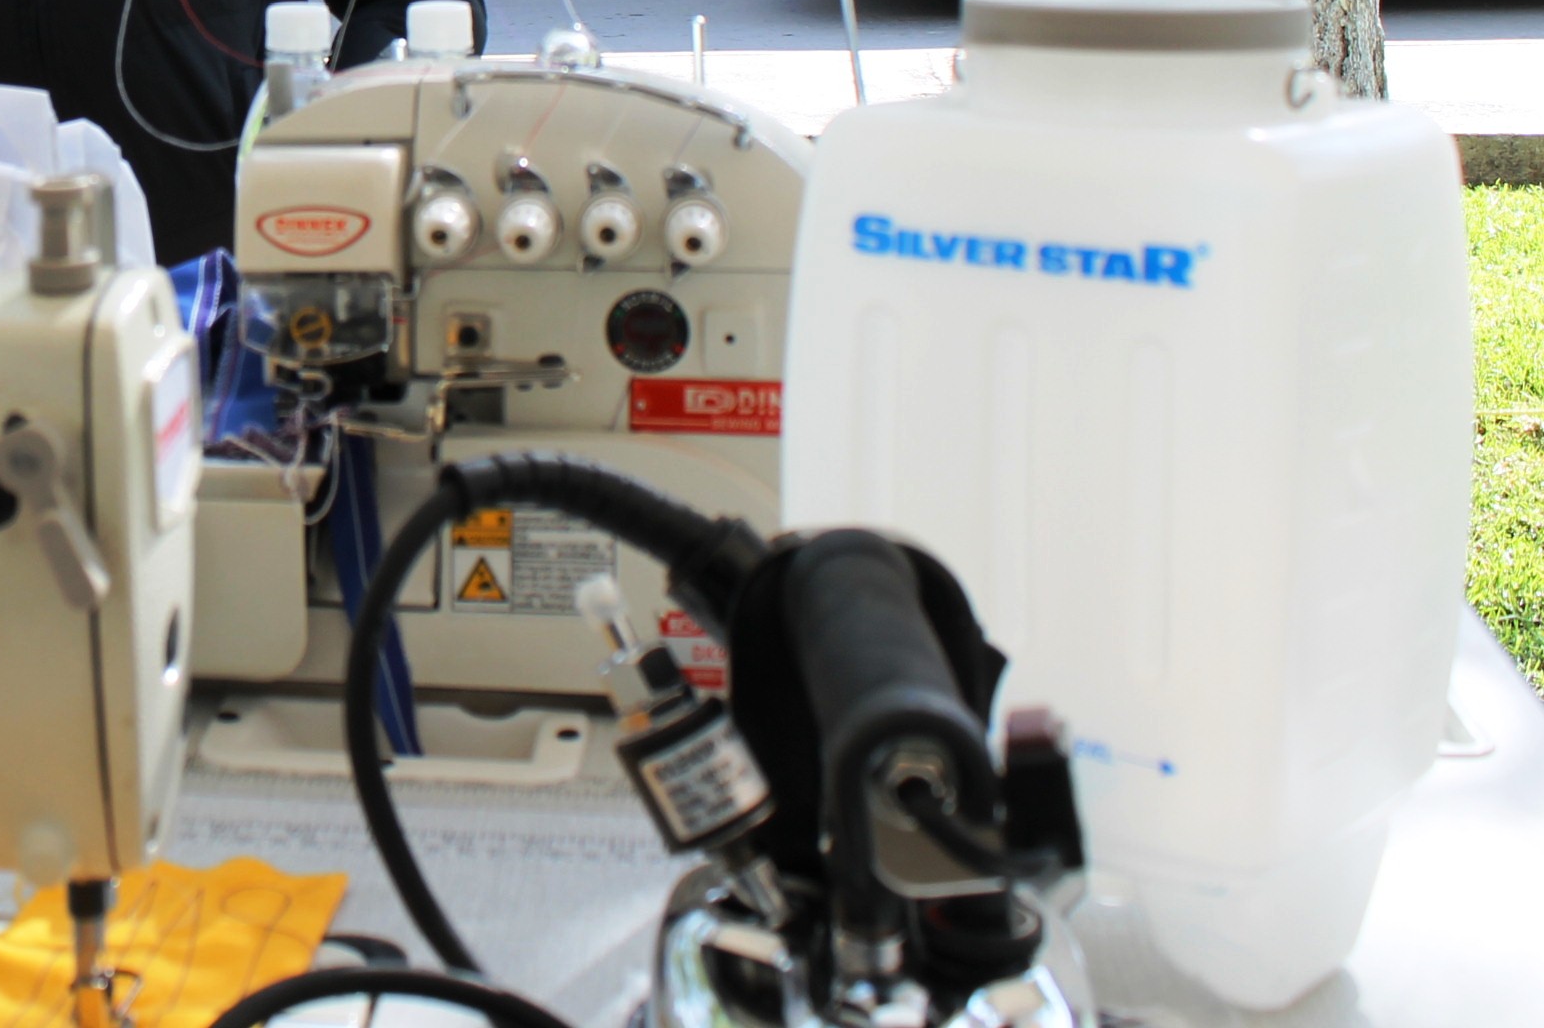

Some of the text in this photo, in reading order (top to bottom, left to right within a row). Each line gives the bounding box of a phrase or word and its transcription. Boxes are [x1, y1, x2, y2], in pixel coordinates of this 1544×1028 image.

[852, 214, 1194, 290] SILVER STAR
[737, 388, 781, 416] DIN
